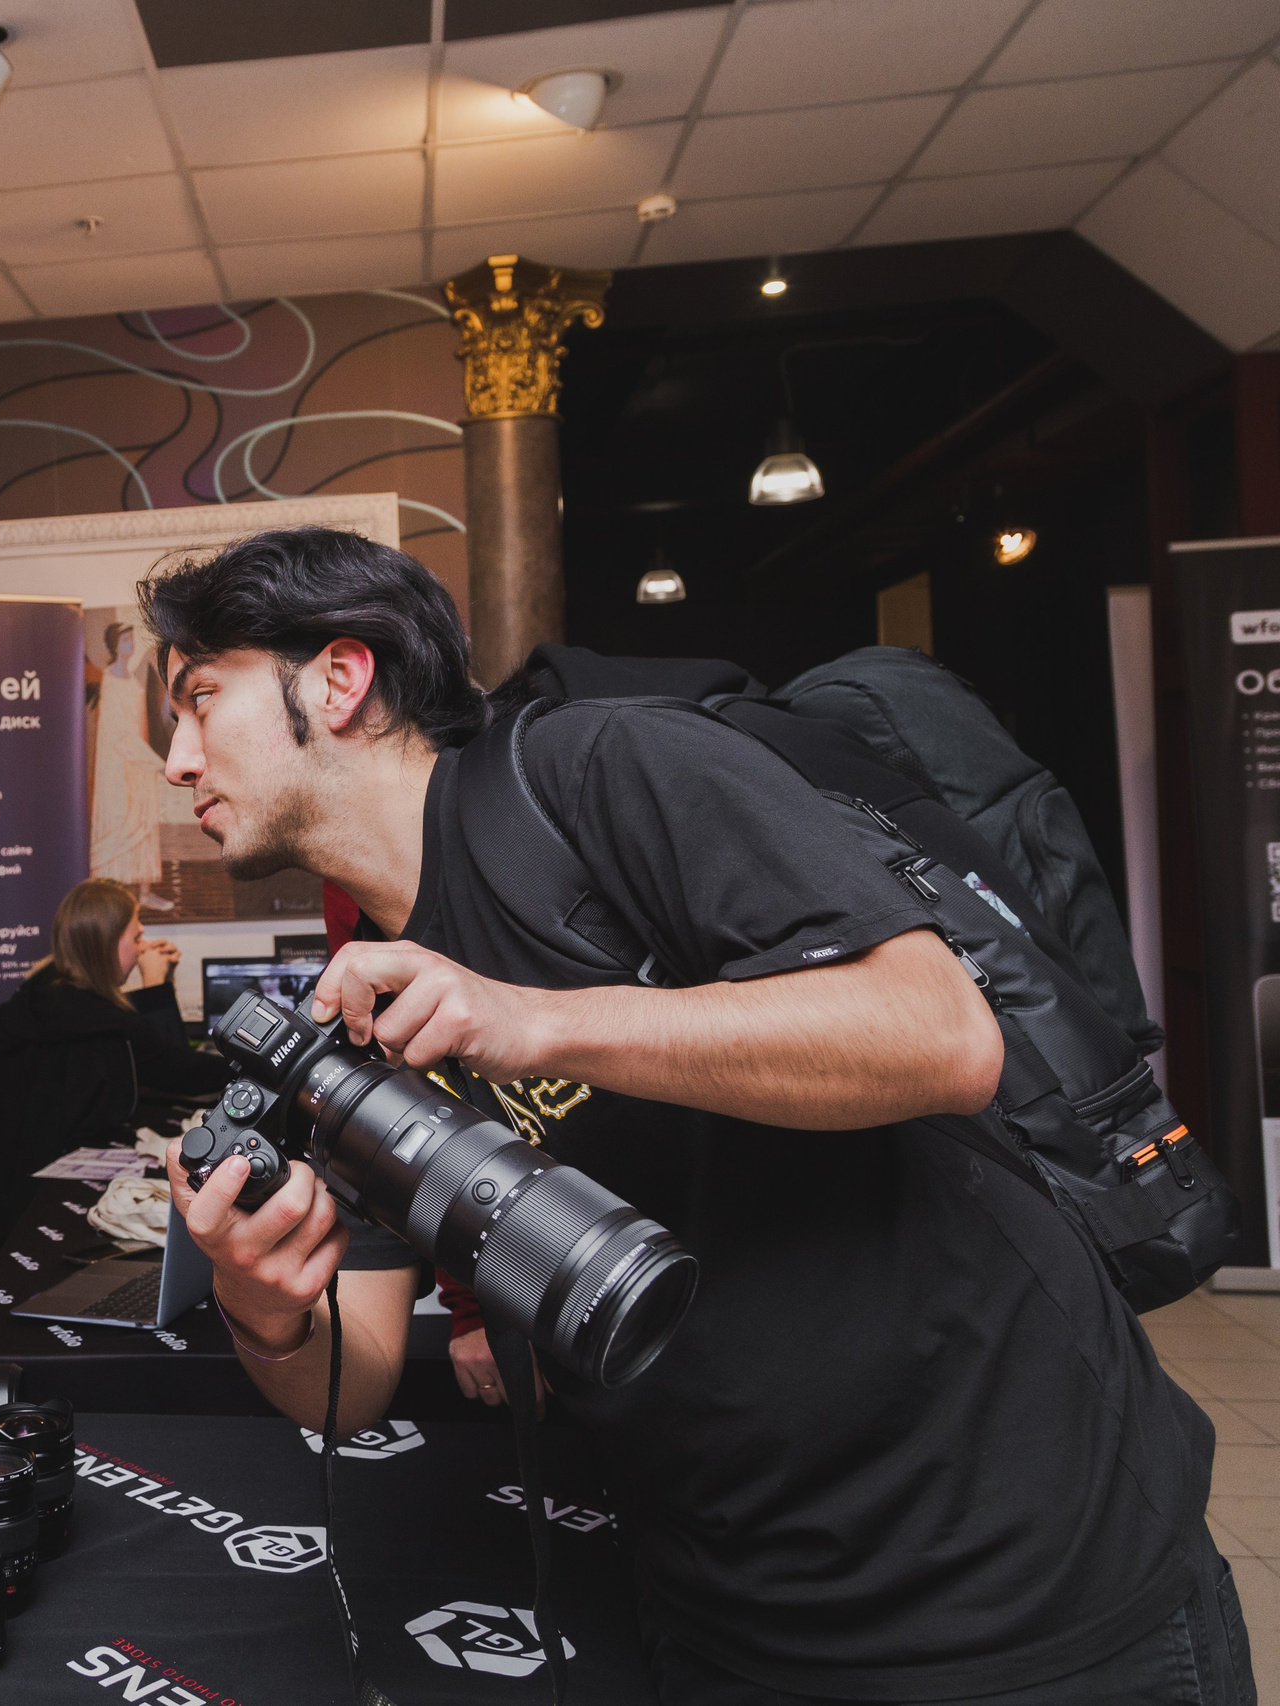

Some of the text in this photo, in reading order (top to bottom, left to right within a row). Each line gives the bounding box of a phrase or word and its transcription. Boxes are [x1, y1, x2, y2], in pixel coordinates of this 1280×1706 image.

[0, 714, 41, 731] диск
[269, 1031, 302, 1068] Nikon
[9, 1251, 40, 1271] wfolio
[46, 1324, 84, 1348] wfolio
[261, 1538, 296, 1558] GL
[459, 1618, 524, 1654] GL
[110, 1636, 163, 1669] STORE
[161, 1667, 220, 1700] PHOTO
